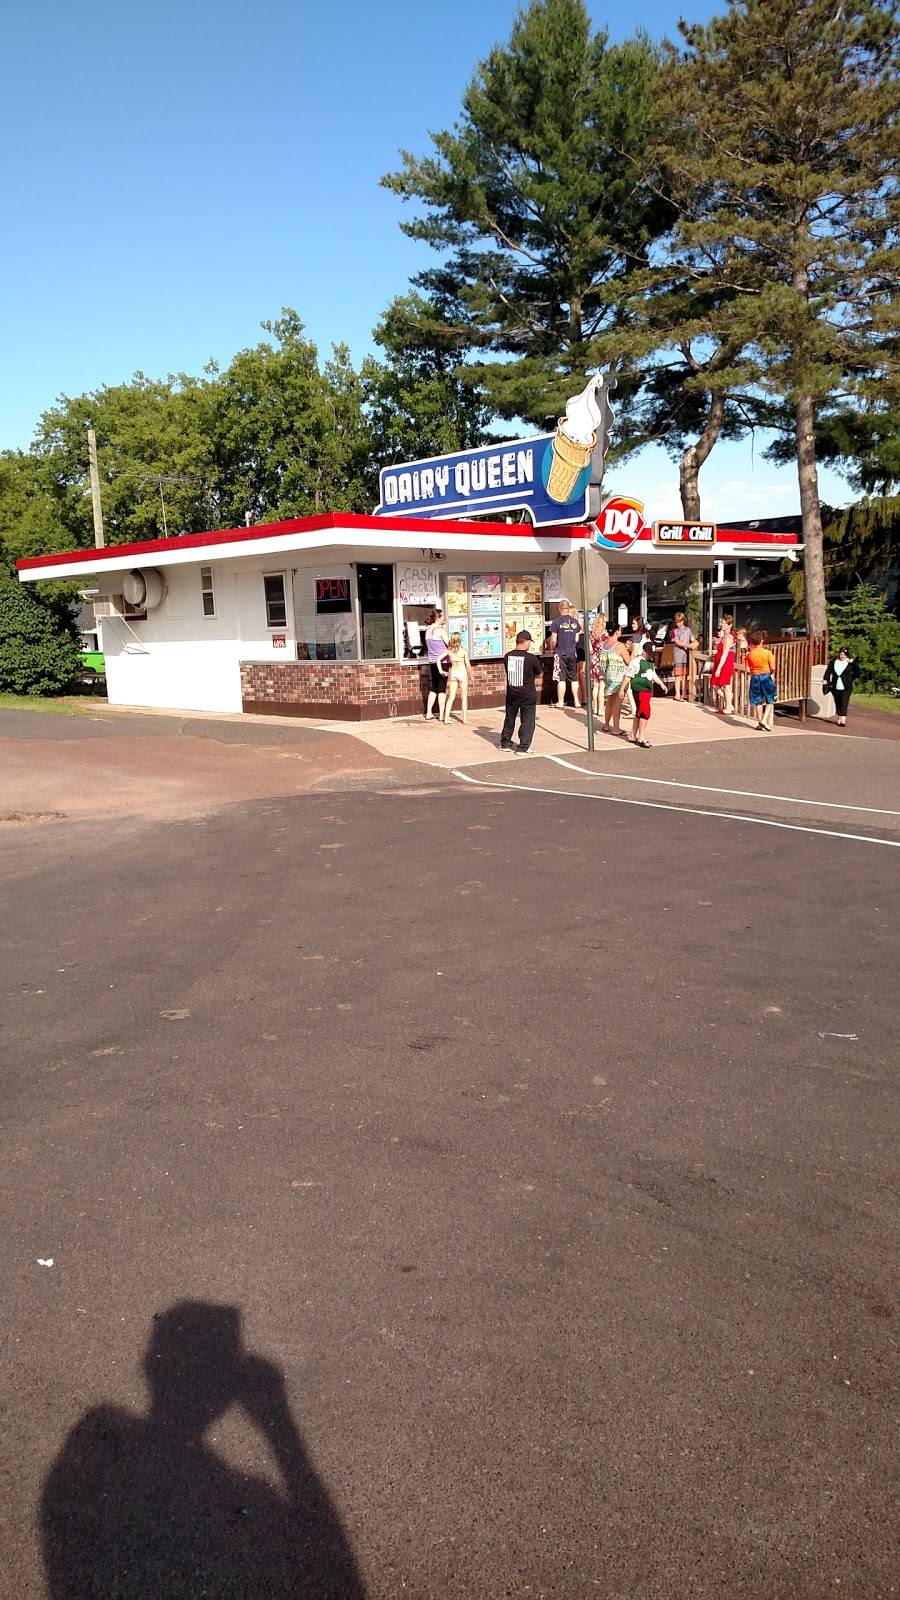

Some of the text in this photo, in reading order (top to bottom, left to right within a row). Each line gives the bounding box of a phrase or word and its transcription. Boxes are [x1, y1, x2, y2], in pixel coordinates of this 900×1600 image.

[385, 449, 534, 505] DAIRY QUEEN
[603, 509, 638, 538] DQ
[660, 526, 683, 540] Grill
[689, 527, 713, 540] Chill
[316, 579, 348, 599] OPEN
